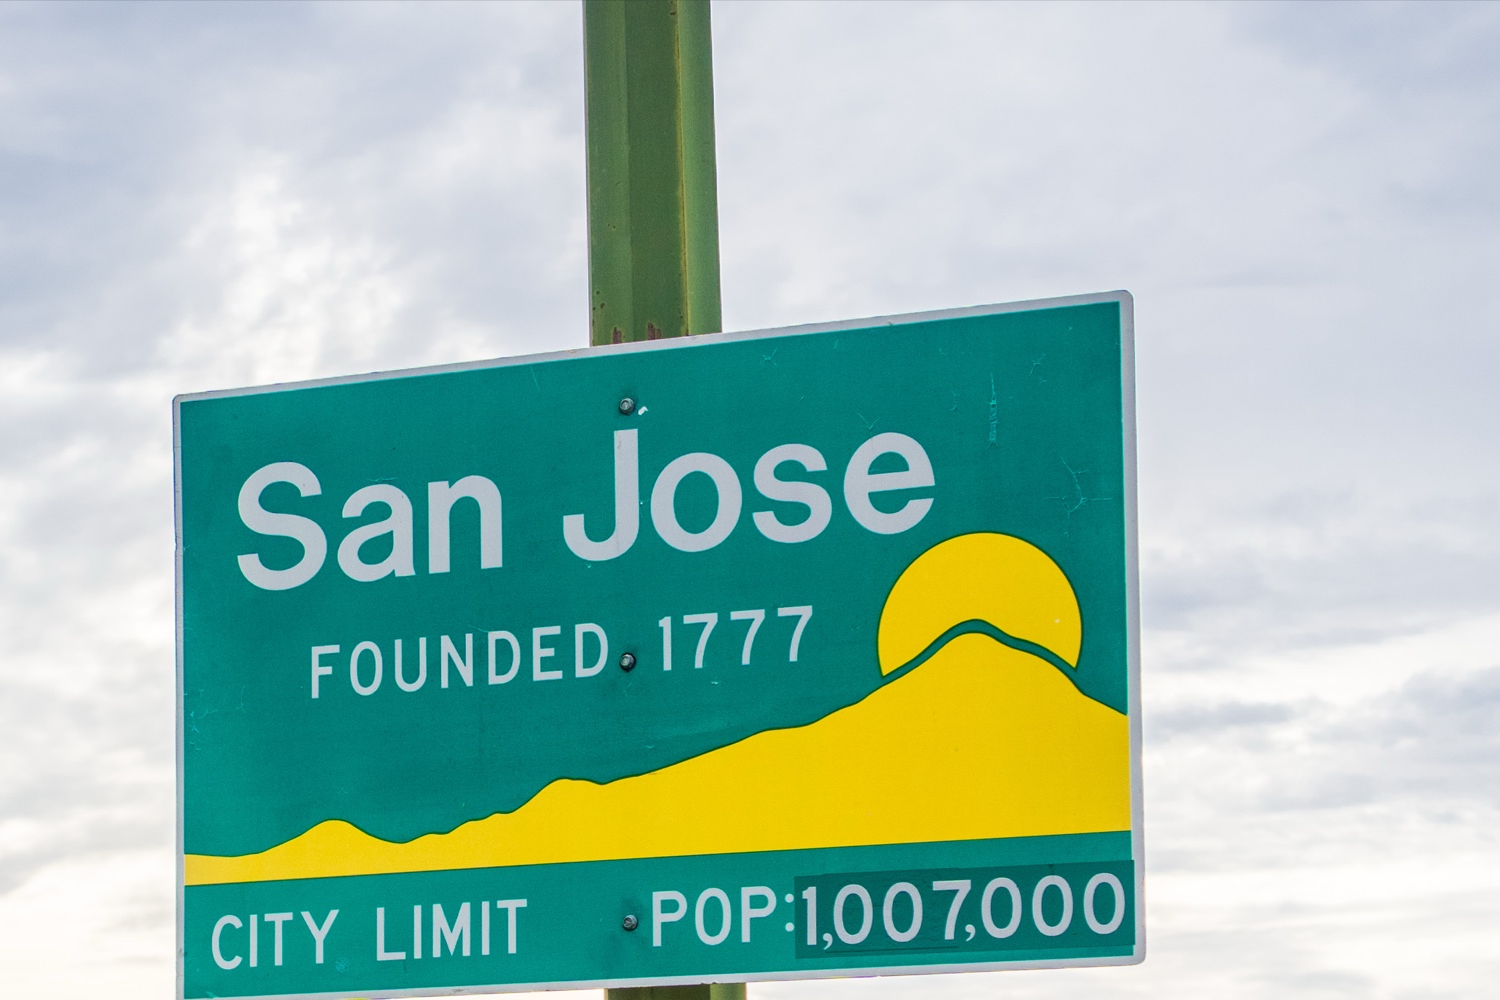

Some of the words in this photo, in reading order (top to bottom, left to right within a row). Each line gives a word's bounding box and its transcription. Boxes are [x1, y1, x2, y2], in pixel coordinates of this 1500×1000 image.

[236, 461, 503, 591] San
[563, 429, 936, 561] Jose
[311, 622, 609, 699] FOUNDED
[658, 605, 813, 672] 1777
[211, 908, 339, 970] CITY
[376, 899, 527, 961] LIMIT
